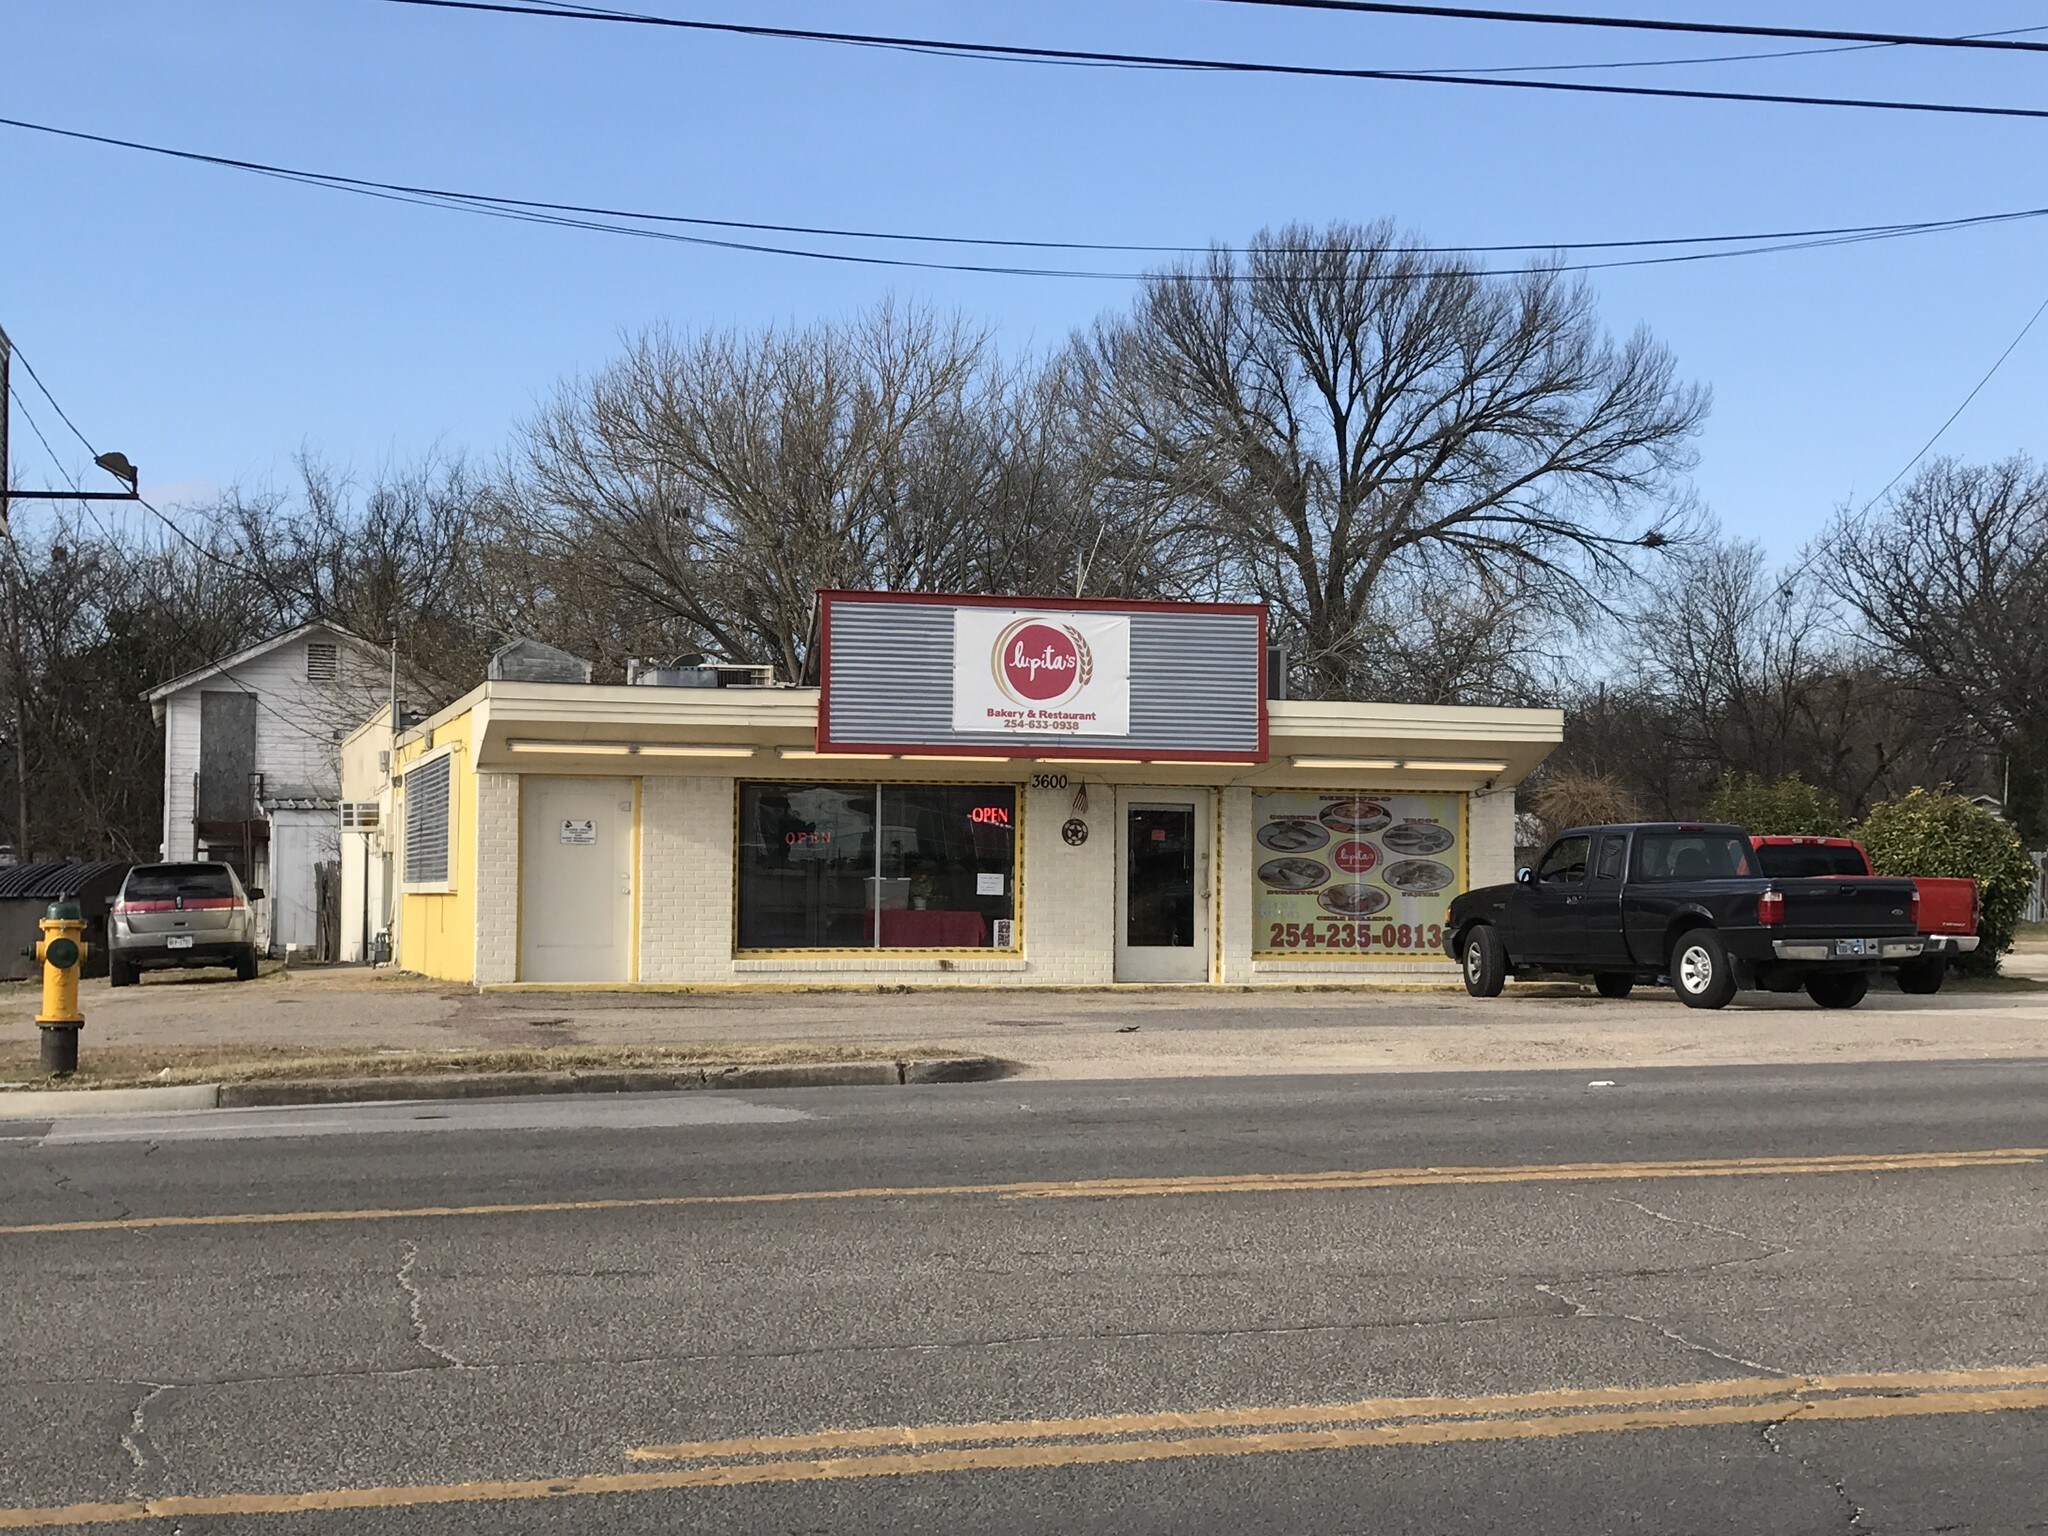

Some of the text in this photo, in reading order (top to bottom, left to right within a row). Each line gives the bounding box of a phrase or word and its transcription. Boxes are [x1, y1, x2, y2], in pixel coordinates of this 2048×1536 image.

[987, 708, 1096, 721] Bakery & Restaurant
[1003, 719, 1079, 730] 254-633-0938
[1031, 774, 1068, 789] 3600
[972, 807, 1009, 823] OPEN
[784, 831, 831, 845] OPEN
[1270, 922, 1442, 948] 254-235-0813
